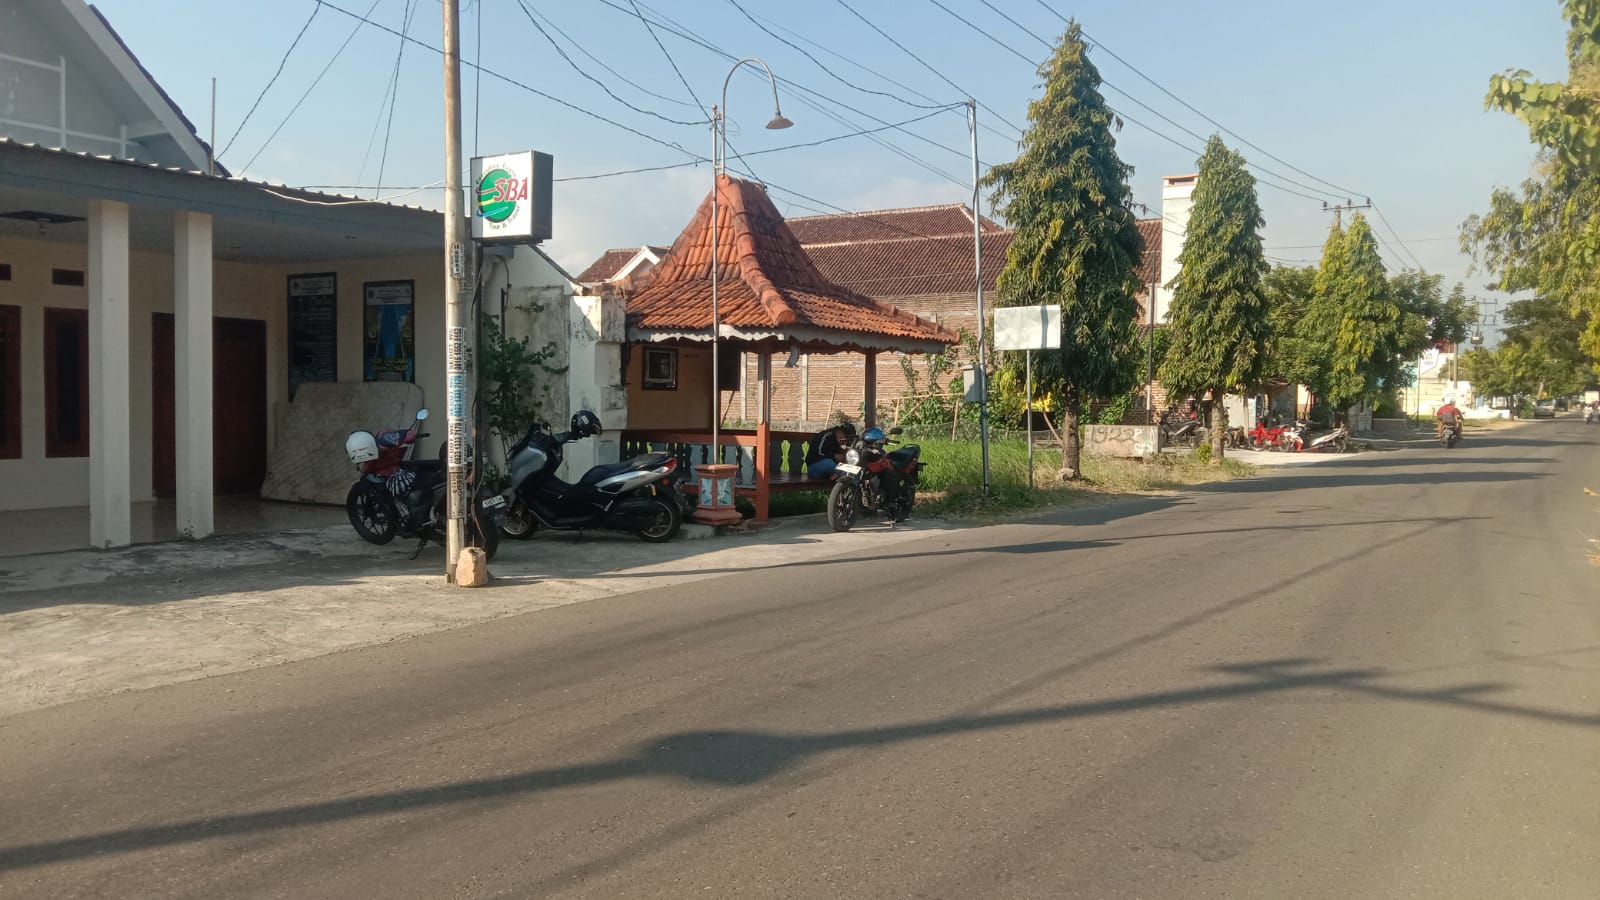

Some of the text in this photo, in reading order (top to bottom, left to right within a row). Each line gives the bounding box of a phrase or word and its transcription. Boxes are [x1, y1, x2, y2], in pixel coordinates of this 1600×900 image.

[493, 177, 528, 201] SBA
[489, 222, 500, 230] Tour
[508, 205, 521, 224] Travel
